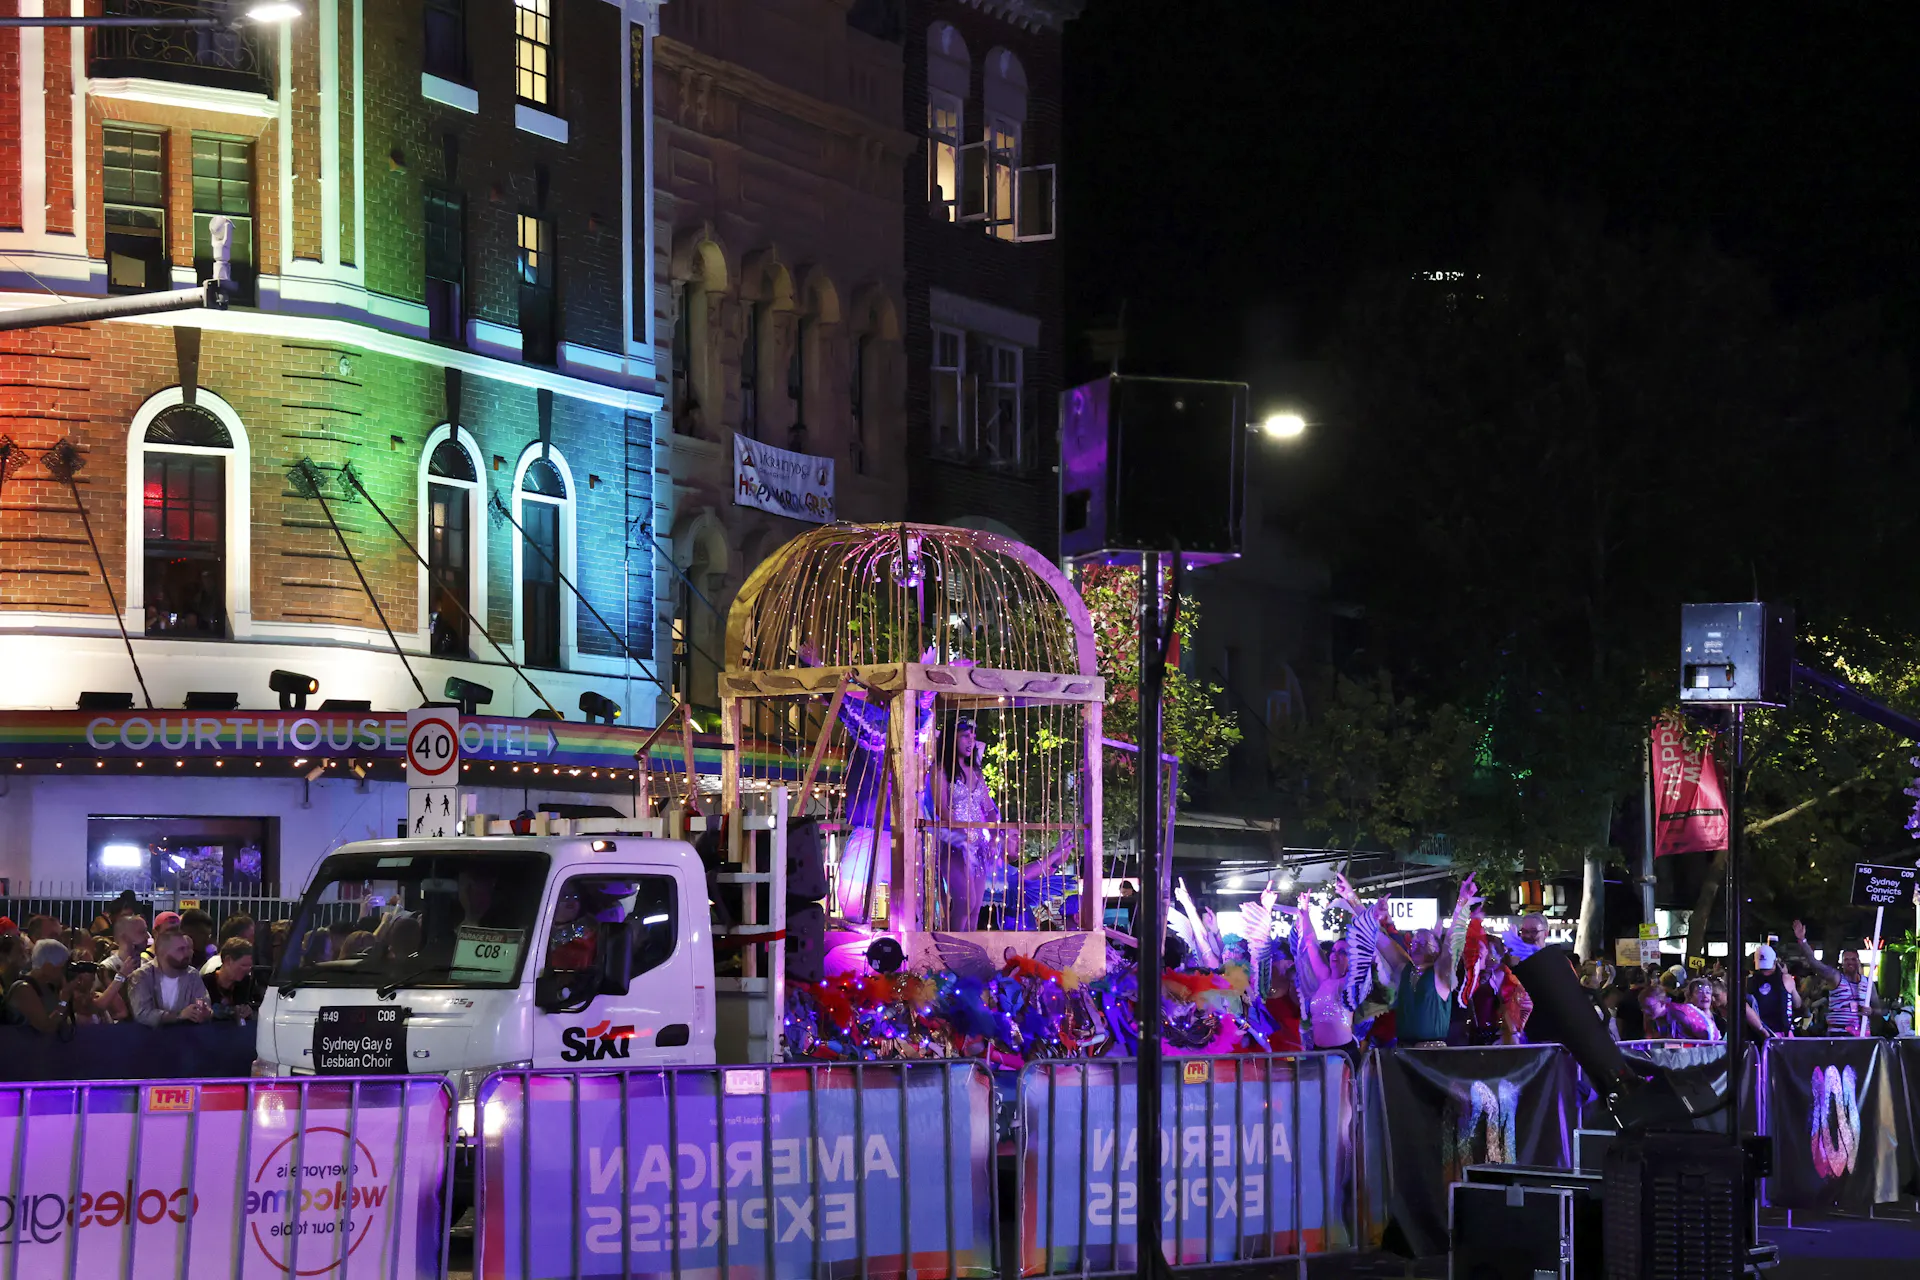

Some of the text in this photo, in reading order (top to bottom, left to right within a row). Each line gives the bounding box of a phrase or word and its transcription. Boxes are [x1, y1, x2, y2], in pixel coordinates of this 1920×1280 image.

[86, 717, 538, 757] COURTHOUSE OTEL
[415, 734, 450, 759] 40
[1901, 870, 1915, 878] C09
[1870, 877, 1900, 887] Sydney
[1866, 885, 1902, 895] Convicts
[1871, 894, 1895, 903] RUFC
[475, 944, 501, 958] C08
[322, 1010, 339, 1022] #49
[377, 1010, 396, 1022] C08
[322, 1036, 393, 1053] Sydney Gay &
[321, 1054, 393, 1068] Lesbian Choir
[155, 1089, 187, 1104] TFH
